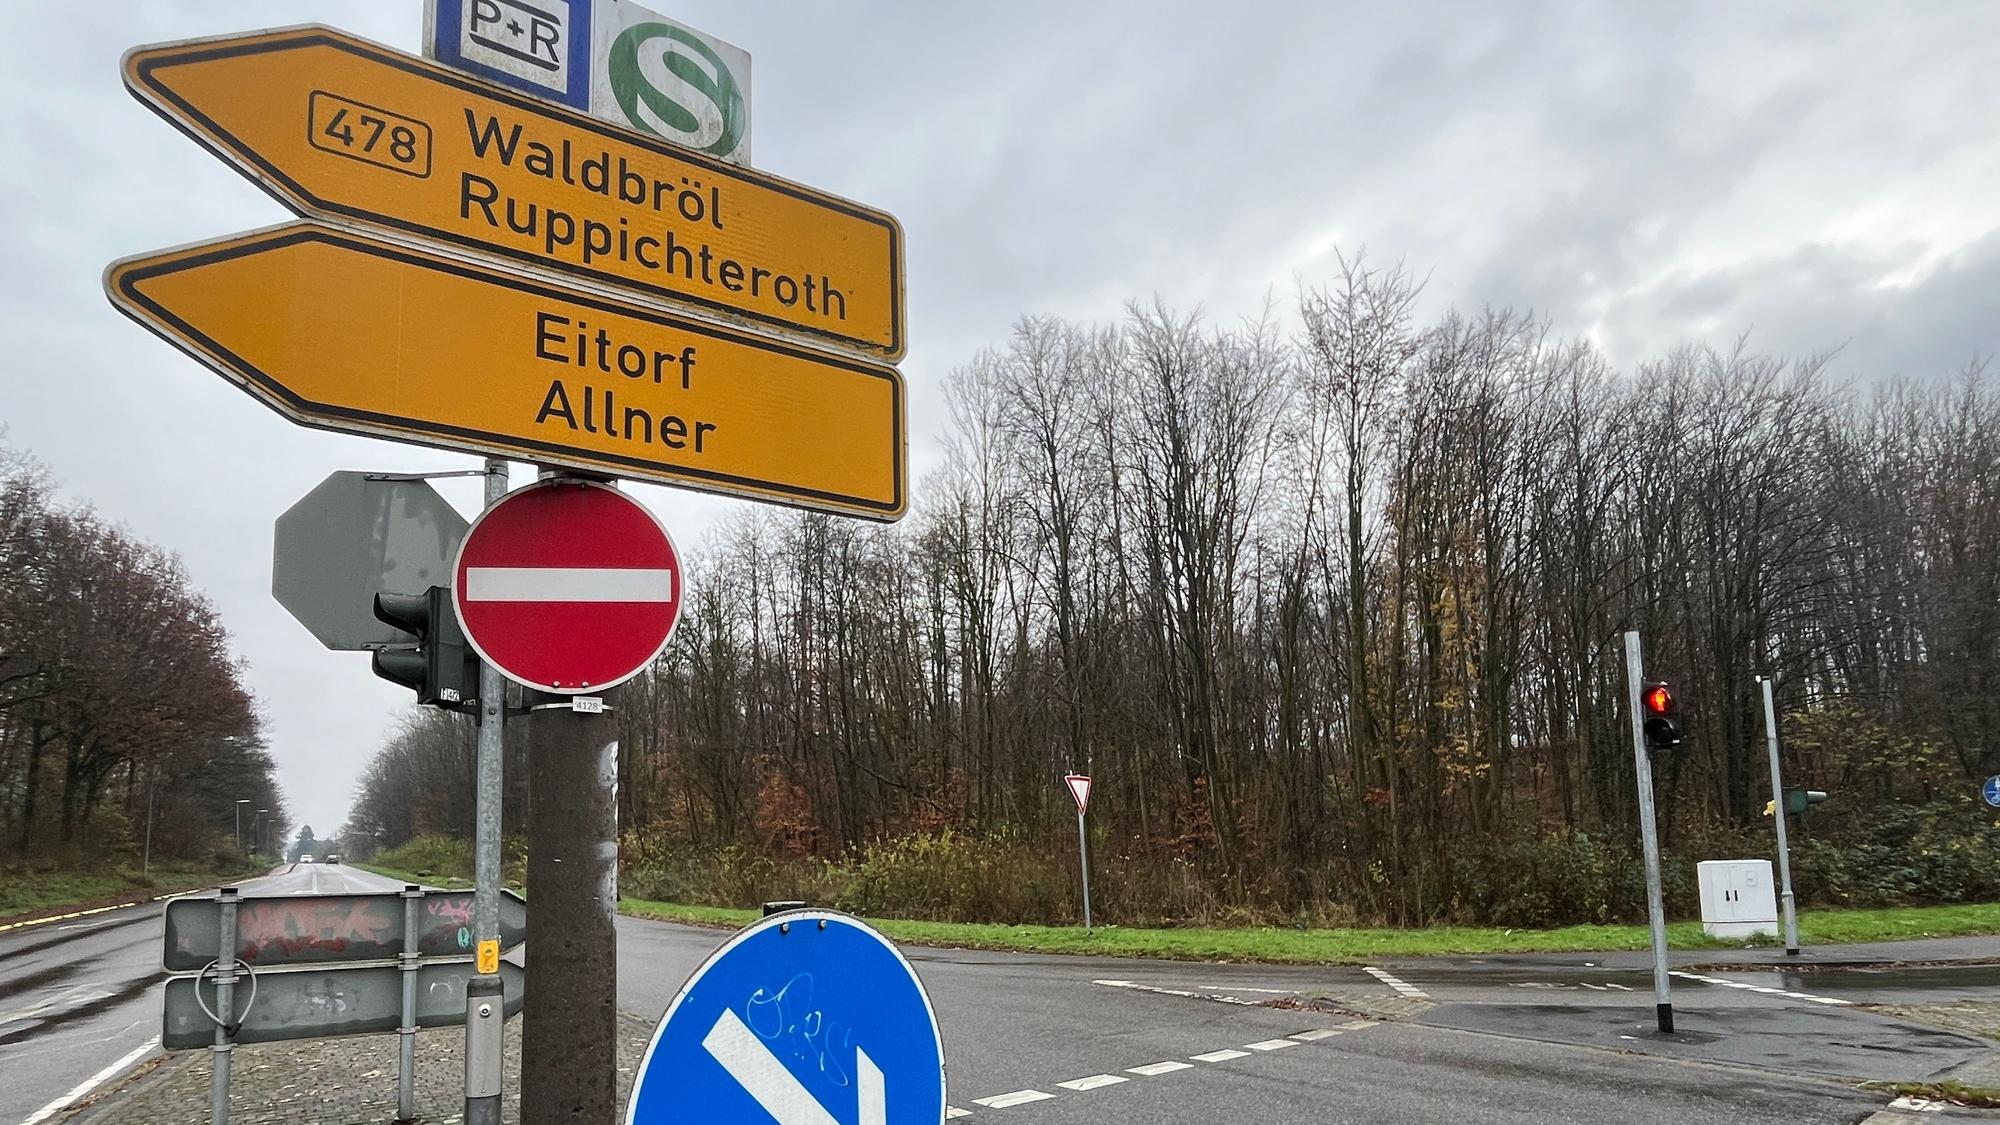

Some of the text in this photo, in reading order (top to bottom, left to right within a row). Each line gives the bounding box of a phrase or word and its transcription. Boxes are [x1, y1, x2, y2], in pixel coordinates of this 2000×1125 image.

[470, 0, 560, 63] P+R
[637, 36, 724, 149] S
[324, 108, 417, 163] 478
[464, 108, 724, 230] Waldbröl
[461, 172, 846, 320] Ruppichteroth
[536, 312, 696, 389] Eitorf
[536, 380, 718, 453] Allner
[576, 701, 599, 711] 4128
